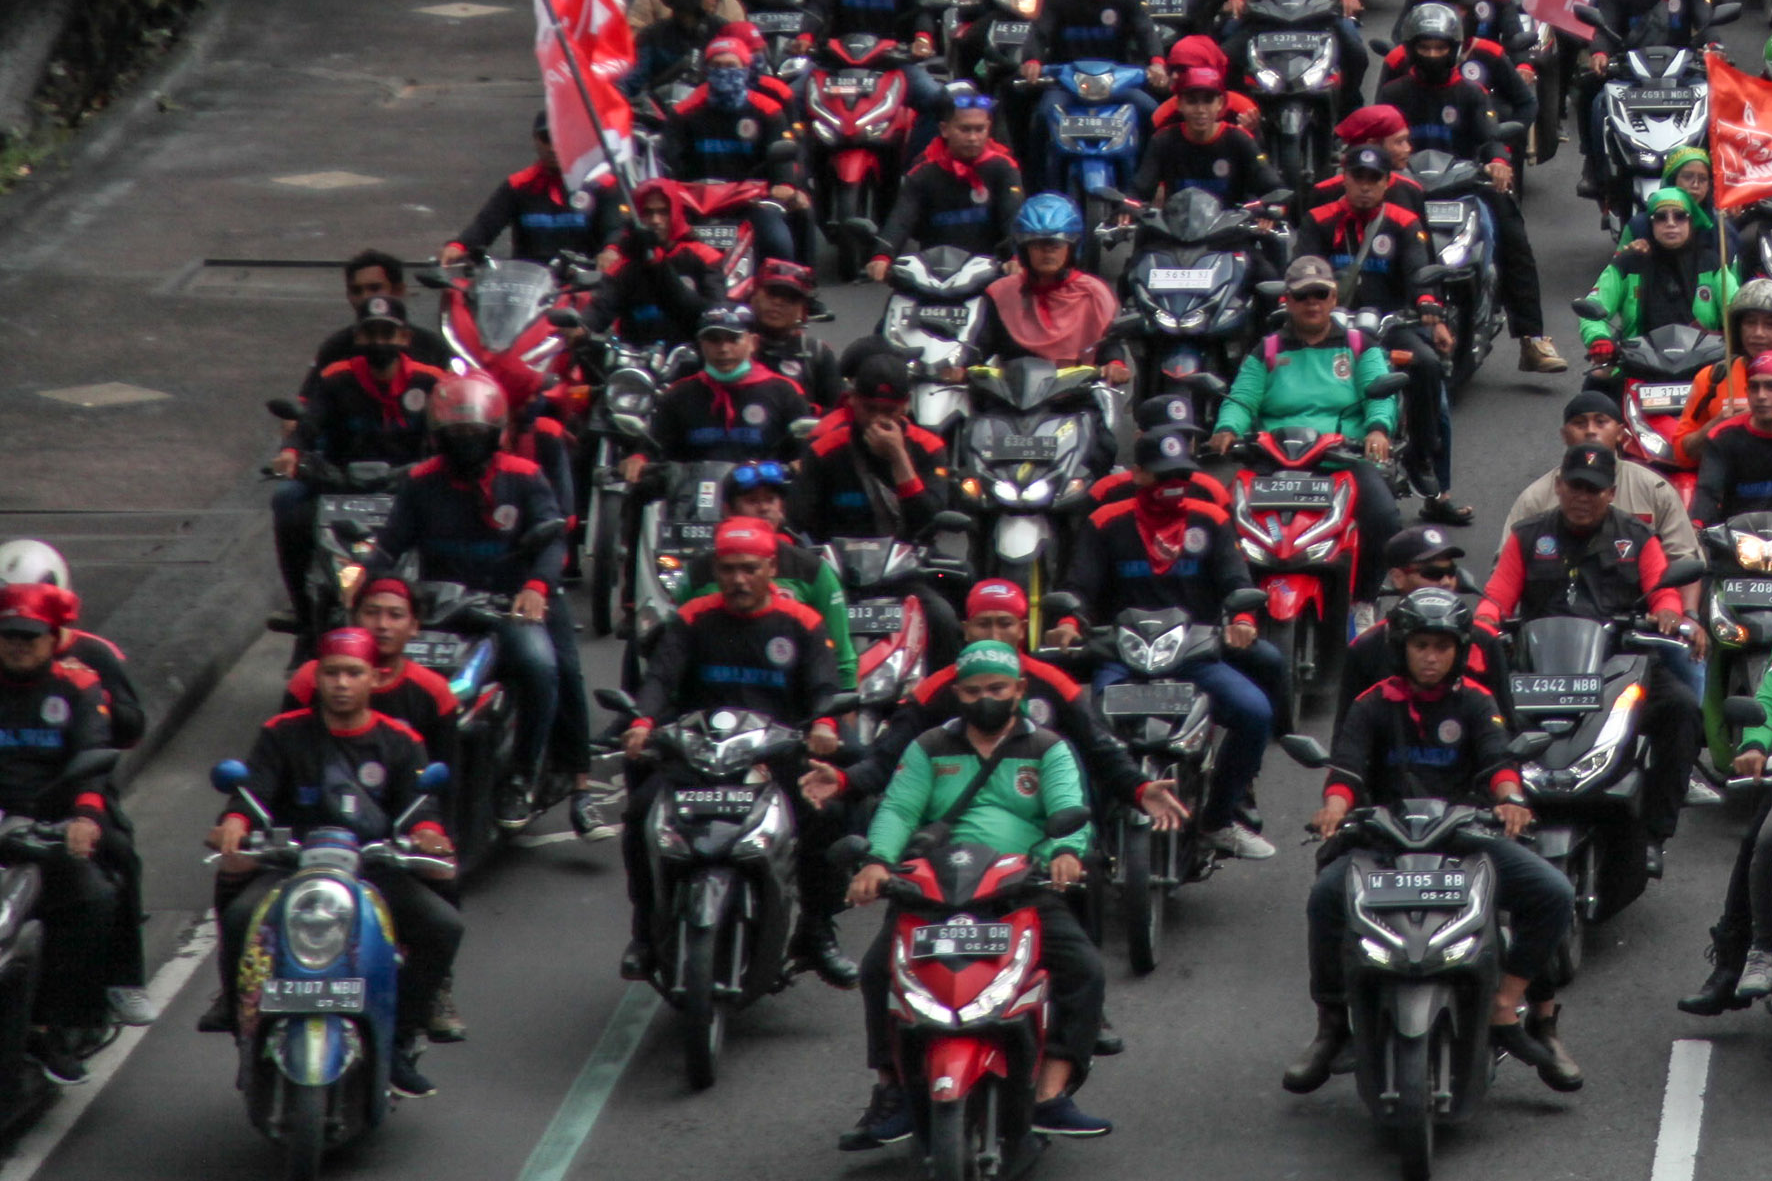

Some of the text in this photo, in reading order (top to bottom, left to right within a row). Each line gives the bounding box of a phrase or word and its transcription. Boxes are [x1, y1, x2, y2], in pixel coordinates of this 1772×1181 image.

[1642, 90, 1665, 98] 4691
[1078, 118, 1101, 126] 2188
[1165, 271, 1191, 279] 5651
[1004, 436, 1034, 446] 6326
[1271, 482, 1302, 492] 2507
[1727, 583, 1742, 593] AE
[1533, 680, 1566, 692] 4342
[1395, 875, 1432, 887] 3195
[1445, 875, 1463, 887] RB
[940, 927, 978, 939] 6093
[284, 981, 323, 993] 2107
